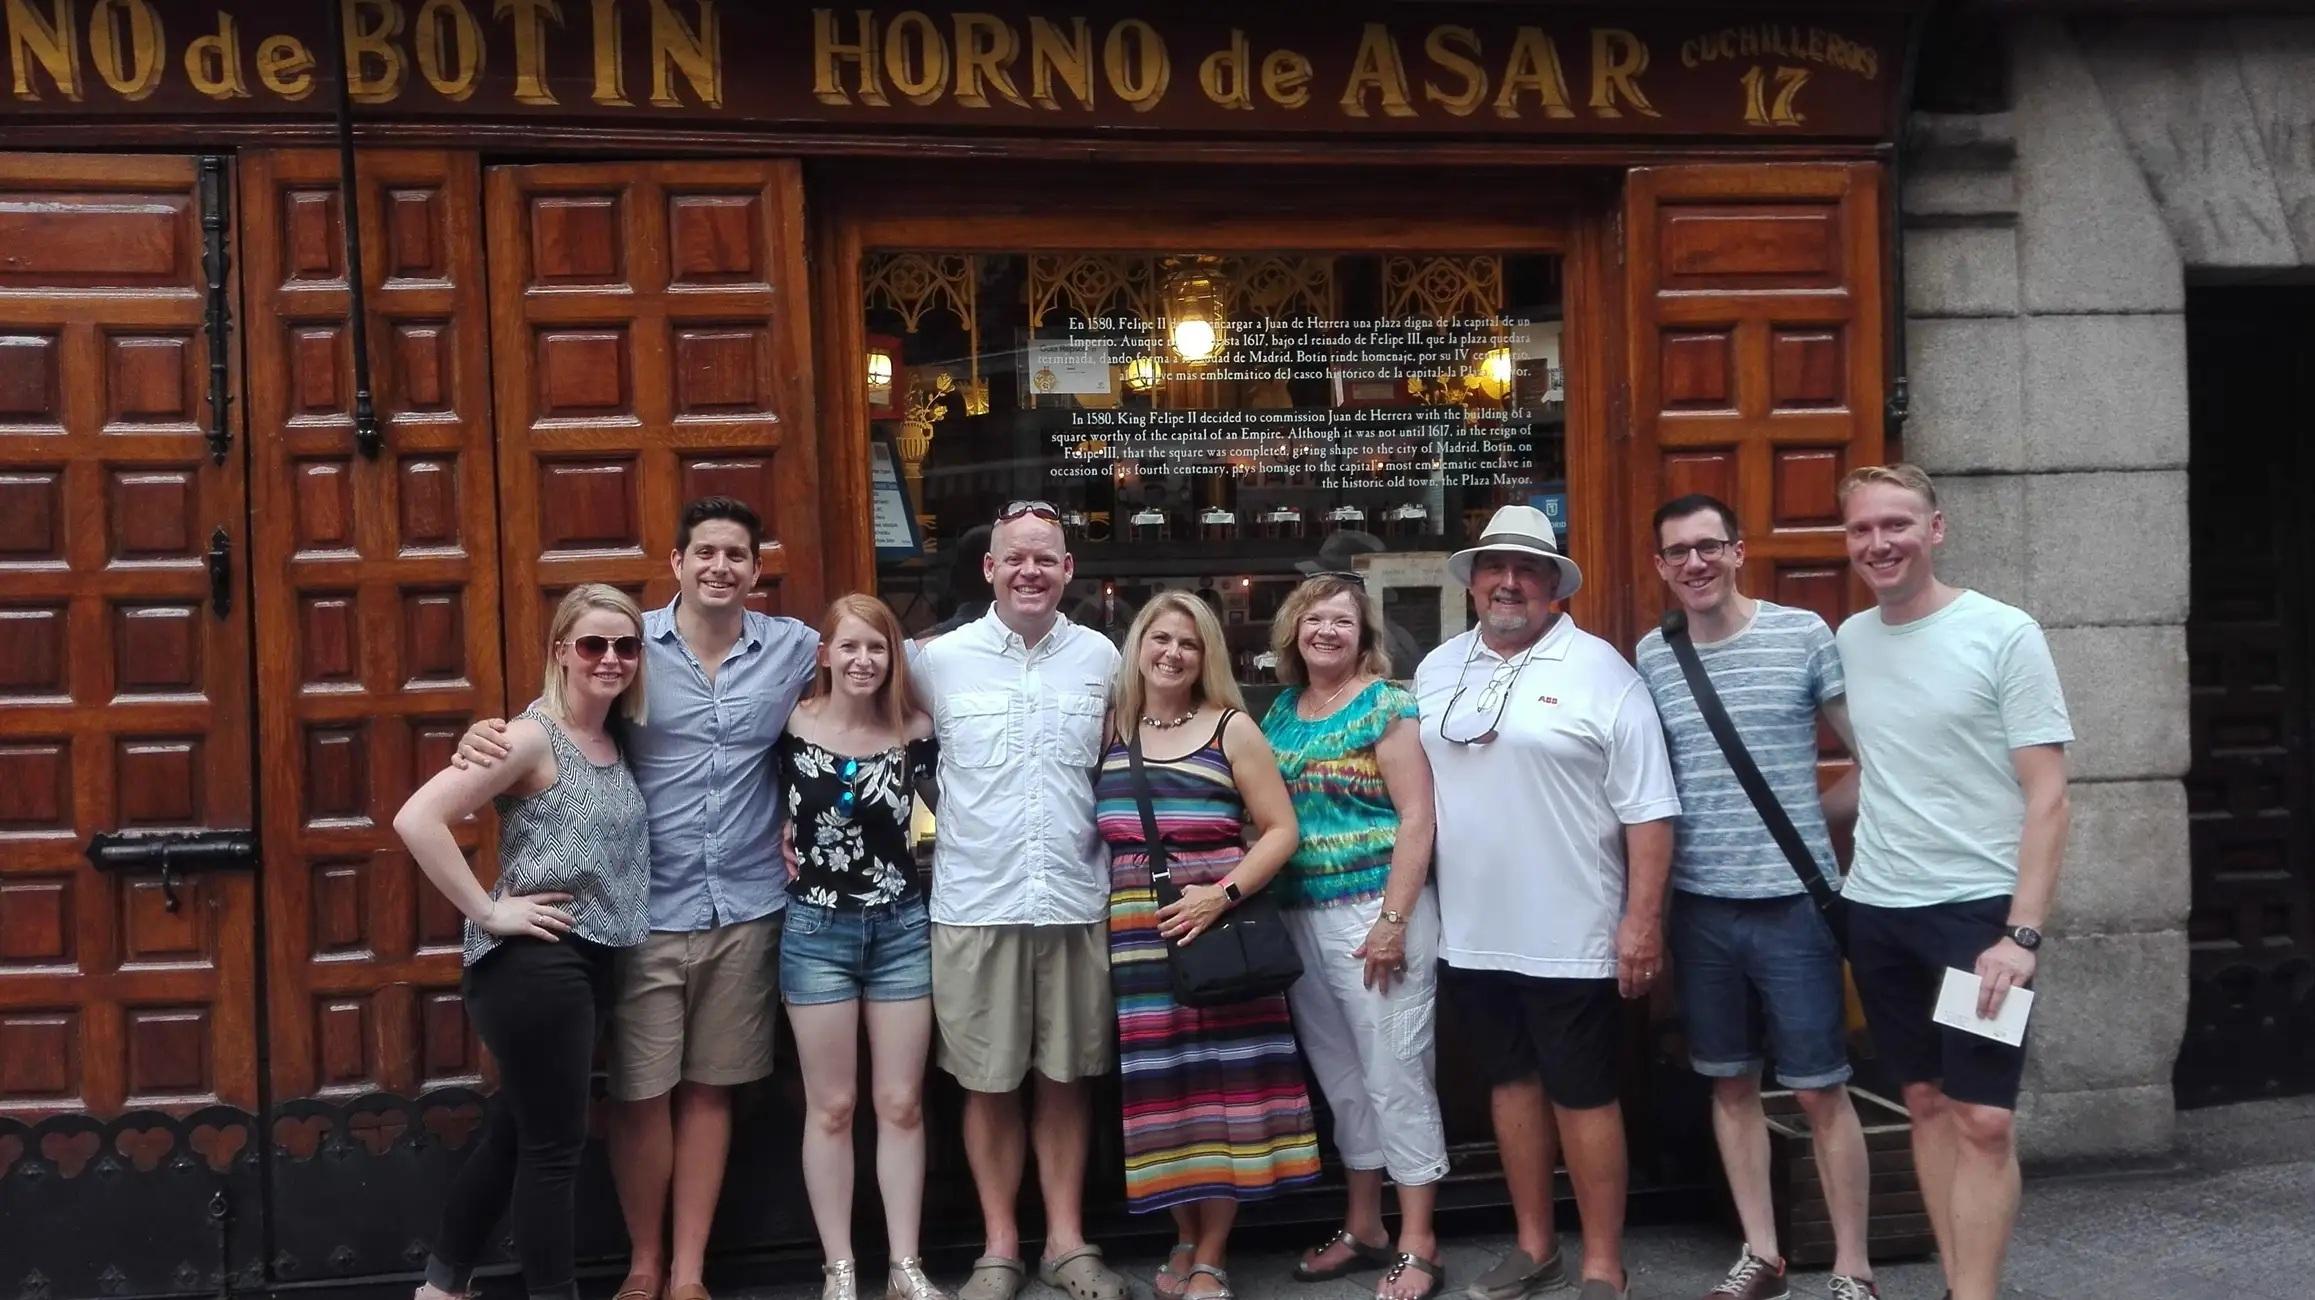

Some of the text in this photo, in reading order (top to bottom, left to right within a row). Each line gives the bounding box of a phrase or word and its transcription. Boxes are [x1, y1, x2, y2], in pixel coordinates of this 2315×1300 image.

[3, 0, 723, 109] NO de BOTIN
[1681, 23, 1878, 80] CUCHILLEROS
[812, 8, 1663, 118] HORNO de ASAR
[1070, 318, 1084, 329] En
[1119, 318, 1152, 333] Felipe
[1158, 318, 1165, 329] II
[1257, 321, 1261, 329] a
[1265, 317, 1288, 332] Juan
[1292, 318, 1303, 328] de
[1308, 317, 1349, 328] Herrera
[1354, 320, 1370, 328] una
[1375, 317, 1400, 331] plaza
[1405, 317, 1432, 330] digna
[1437, 316, 1448, 327] de
[1452, 317, 1461, 327] la
[1465, 317, 1498, 330] capital
[1503, 316, 1514, 326] de
[1518, 318, 1530, 326] un
[1121, 336, 1163, 350] Aunque
[1272, 334, 1294, 349] bajo
[1298, 335, 1307, 345] el
[1311, 334, 1350, 345] reinado
[1354, 334, 1366, 344] de
[1371, 333, 1404, 348] Felipe
[1426, 336, 1445, 348] que
[1449, 333, 1457, 343] la
[1461, 333, 1486, 348] plaza
[1100, 353, 1132, 364] dando
[1234, 352, 1245, 362] de
[1297, 350, 1327, 362] Botín
[1330, 351, 1358, 362] rinde
[1419, 353, 1436, 364] por
[1455, 349, 1470, 360] IV
[1200, 367, 1271, 380] emblemático
[1275, 368, 1291, 379] del
[1378, 368, 1390, 378] de
[1395, 368, 1402, 378] la
[1448, 367, 1456, 377] la
[1072, 413, 1083, 425] In
[1118, 413, 1145, 427] King
[1150, 412, 1183, 427] Felipe
[1188, 412, 1196, 423] II
[1201, 411, 1241, 424] decided
[1246, 414, 1256, 422] to
[1260, 411, 1325, 422] commission
[1328, 410, 1350, 425] Juan
[1355, 411, 1366, 421] de
[1371, 410, 1412, 421] Herrera
[1416, 410, 1440, 420] with
[1444, 409, 1461, 419] the
[1464, 409, 1508, 421] building
[1511, 409, 1524, 418] of
[1052, 433, 1086, 446] square
[1090, 430, 1130, 445] worthy
[1135, 430, 1147, 440] of
[1151, 430, 1167, 440] the
[1172, 429, 1206, 444] capital
[1210, 430, 1222, 439] of
[1288, 428, 1340, 441] Although
[1345, 428, 1352, 437] it
[1356, 430, 1375, 438] was
[1379, 429, 1395, 437] not
[1400, 426, 1424, 436] until
[1457, 426, 1466, 435] in
[1470, 426, 1486, 435] the
[1490, 425, 1516, 438] reign
[1520, 425, 1531, 435] of
[1065, 448, 1099, 462] Felipe
[1124, 447, 1144, 458] that
[1149, 447, 1165, 457] the
[1169, 450, 1202, 461] square
[1330, 446, 1358, 459] shape
[1377, 444, 1393, 454] the
[1397, 444, 1417, 456] city
[1422, 443, 1433, 453] of
[1050, 466, 1098, 476] occasion
[1101, 465, 1113, 475] of
[1118, 465, 1131, 475] its
[1135, 464, 1169, 474] fourth
[1260, 463, 1300, 476] homage
[1305, 464, 1316, 472] to
[1320, 462, 1336, 471] the
[1386, 461, 1412, 470] most
[1416, 459, 1477, 470] emblematic
[1481, 459, 1518, 469] enclave
[1522, 460, 1532, 468] in
[1322, 479, 1338, 488] the
[1342, 478, 1383, 488] historic
[1388, 477, 1405, 487] old
[1442, 476, 1458, 485] the
[1462, 475, 1490, 485] Plaza
